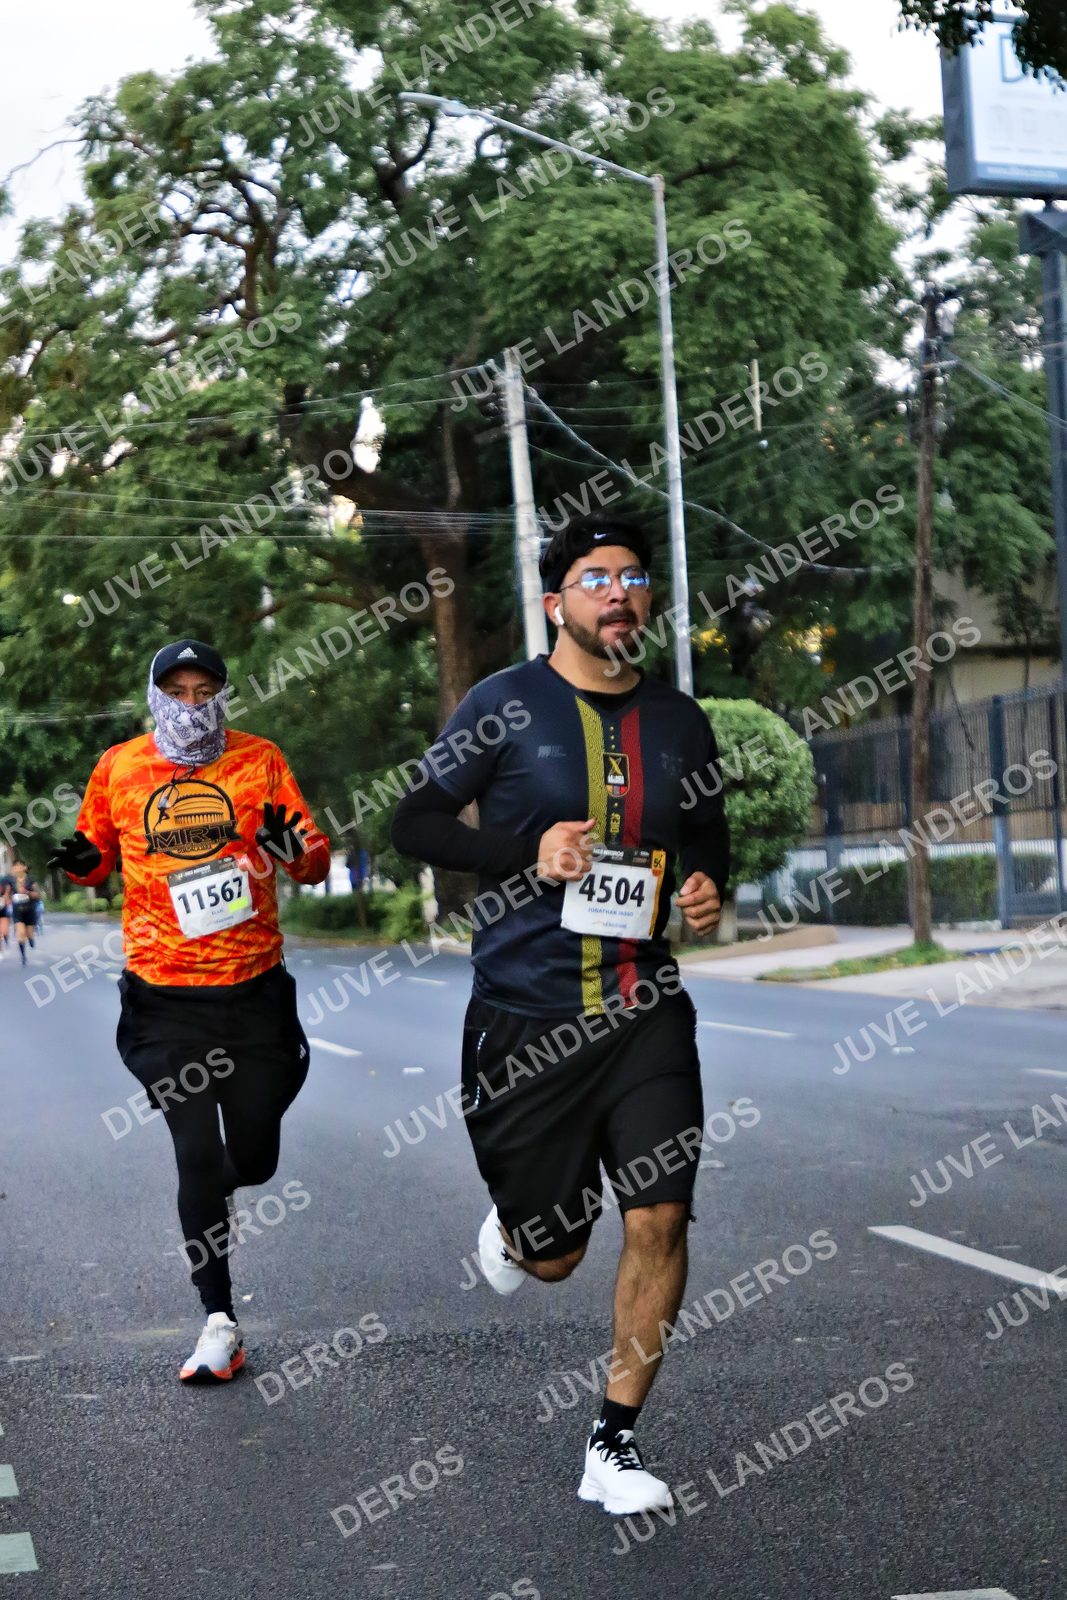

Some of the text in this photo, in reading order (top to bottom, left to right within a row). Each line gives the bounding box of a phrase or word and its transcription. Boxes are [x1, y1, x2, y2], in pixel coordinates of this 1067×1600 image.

[149, 820, 236, 850] MRT
[178, 876, 243, 914] 11567
[579, 873, 645, 907] 4504
